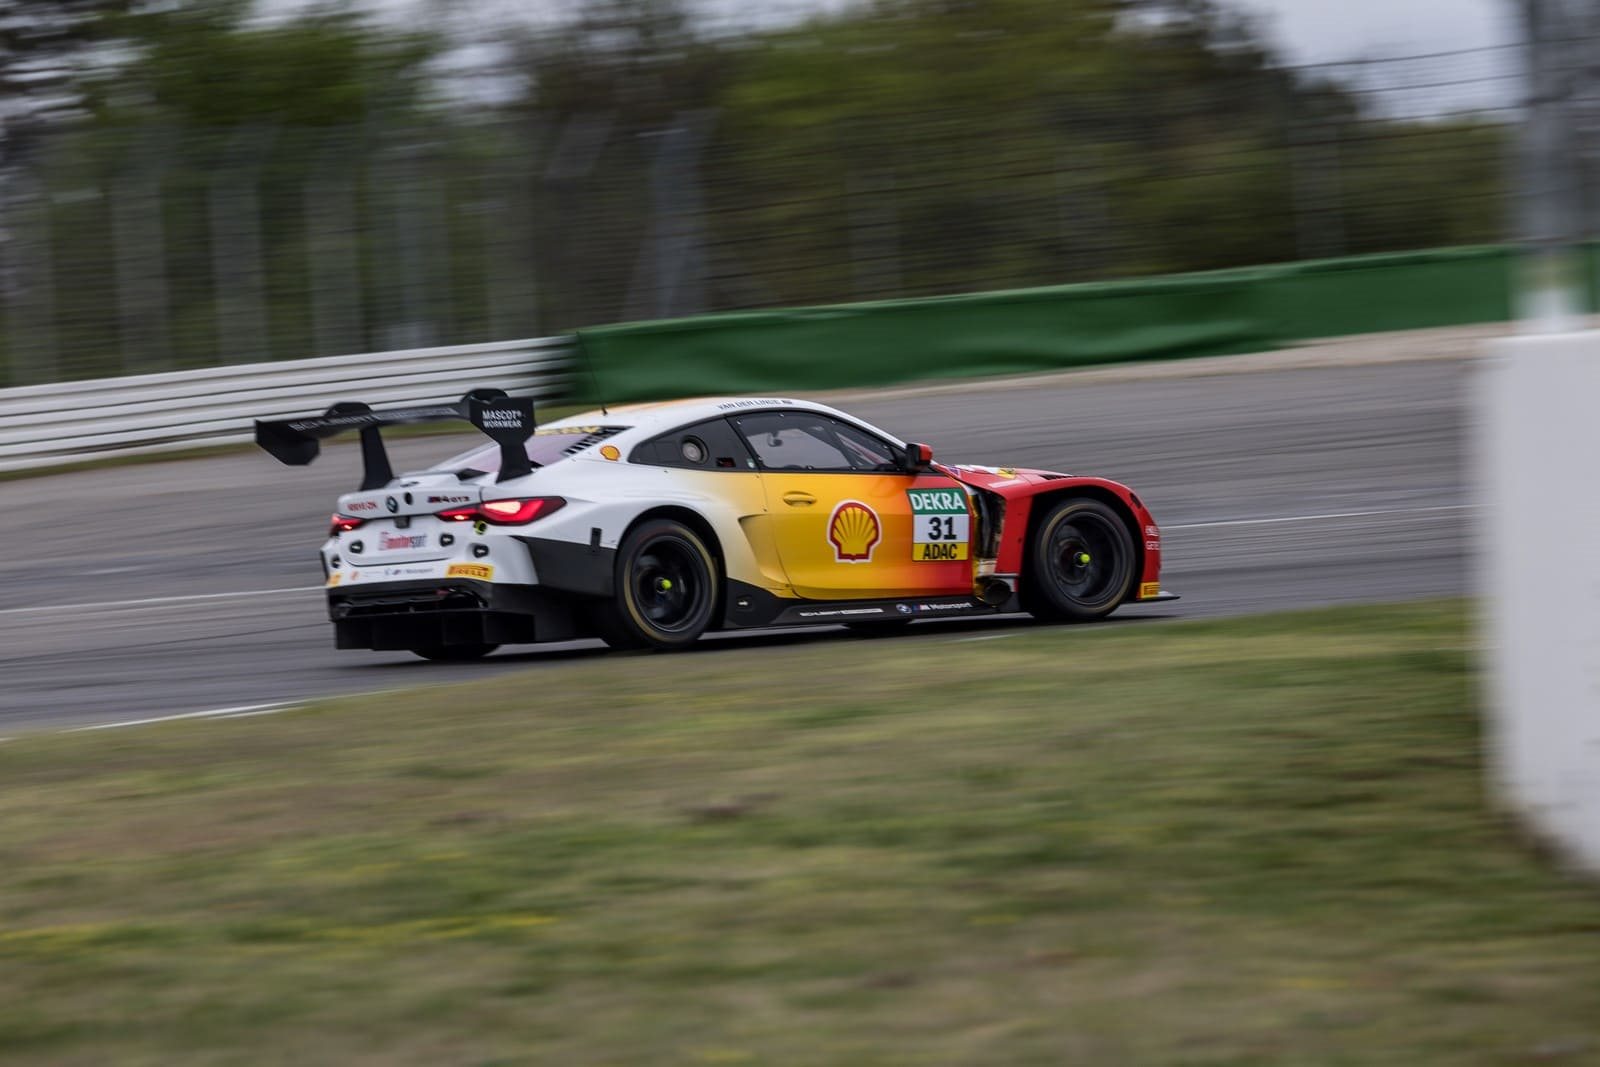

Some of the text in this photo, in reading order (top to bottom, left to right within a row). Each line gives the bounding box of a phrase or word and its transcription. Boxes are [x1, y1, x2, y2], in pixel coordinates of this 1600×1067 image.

[718, 402, 735, 410] VAN
[482, 420, 522, 428] WORKWEAR
[909, 492, 966, 511] DEKRA
[928, 516, 957, 540] 31
[923, 543, 958, 560] ADAC
[447, 564, 489, 577] PIRELLI
[931, 602, 973, 610] Motorsport
